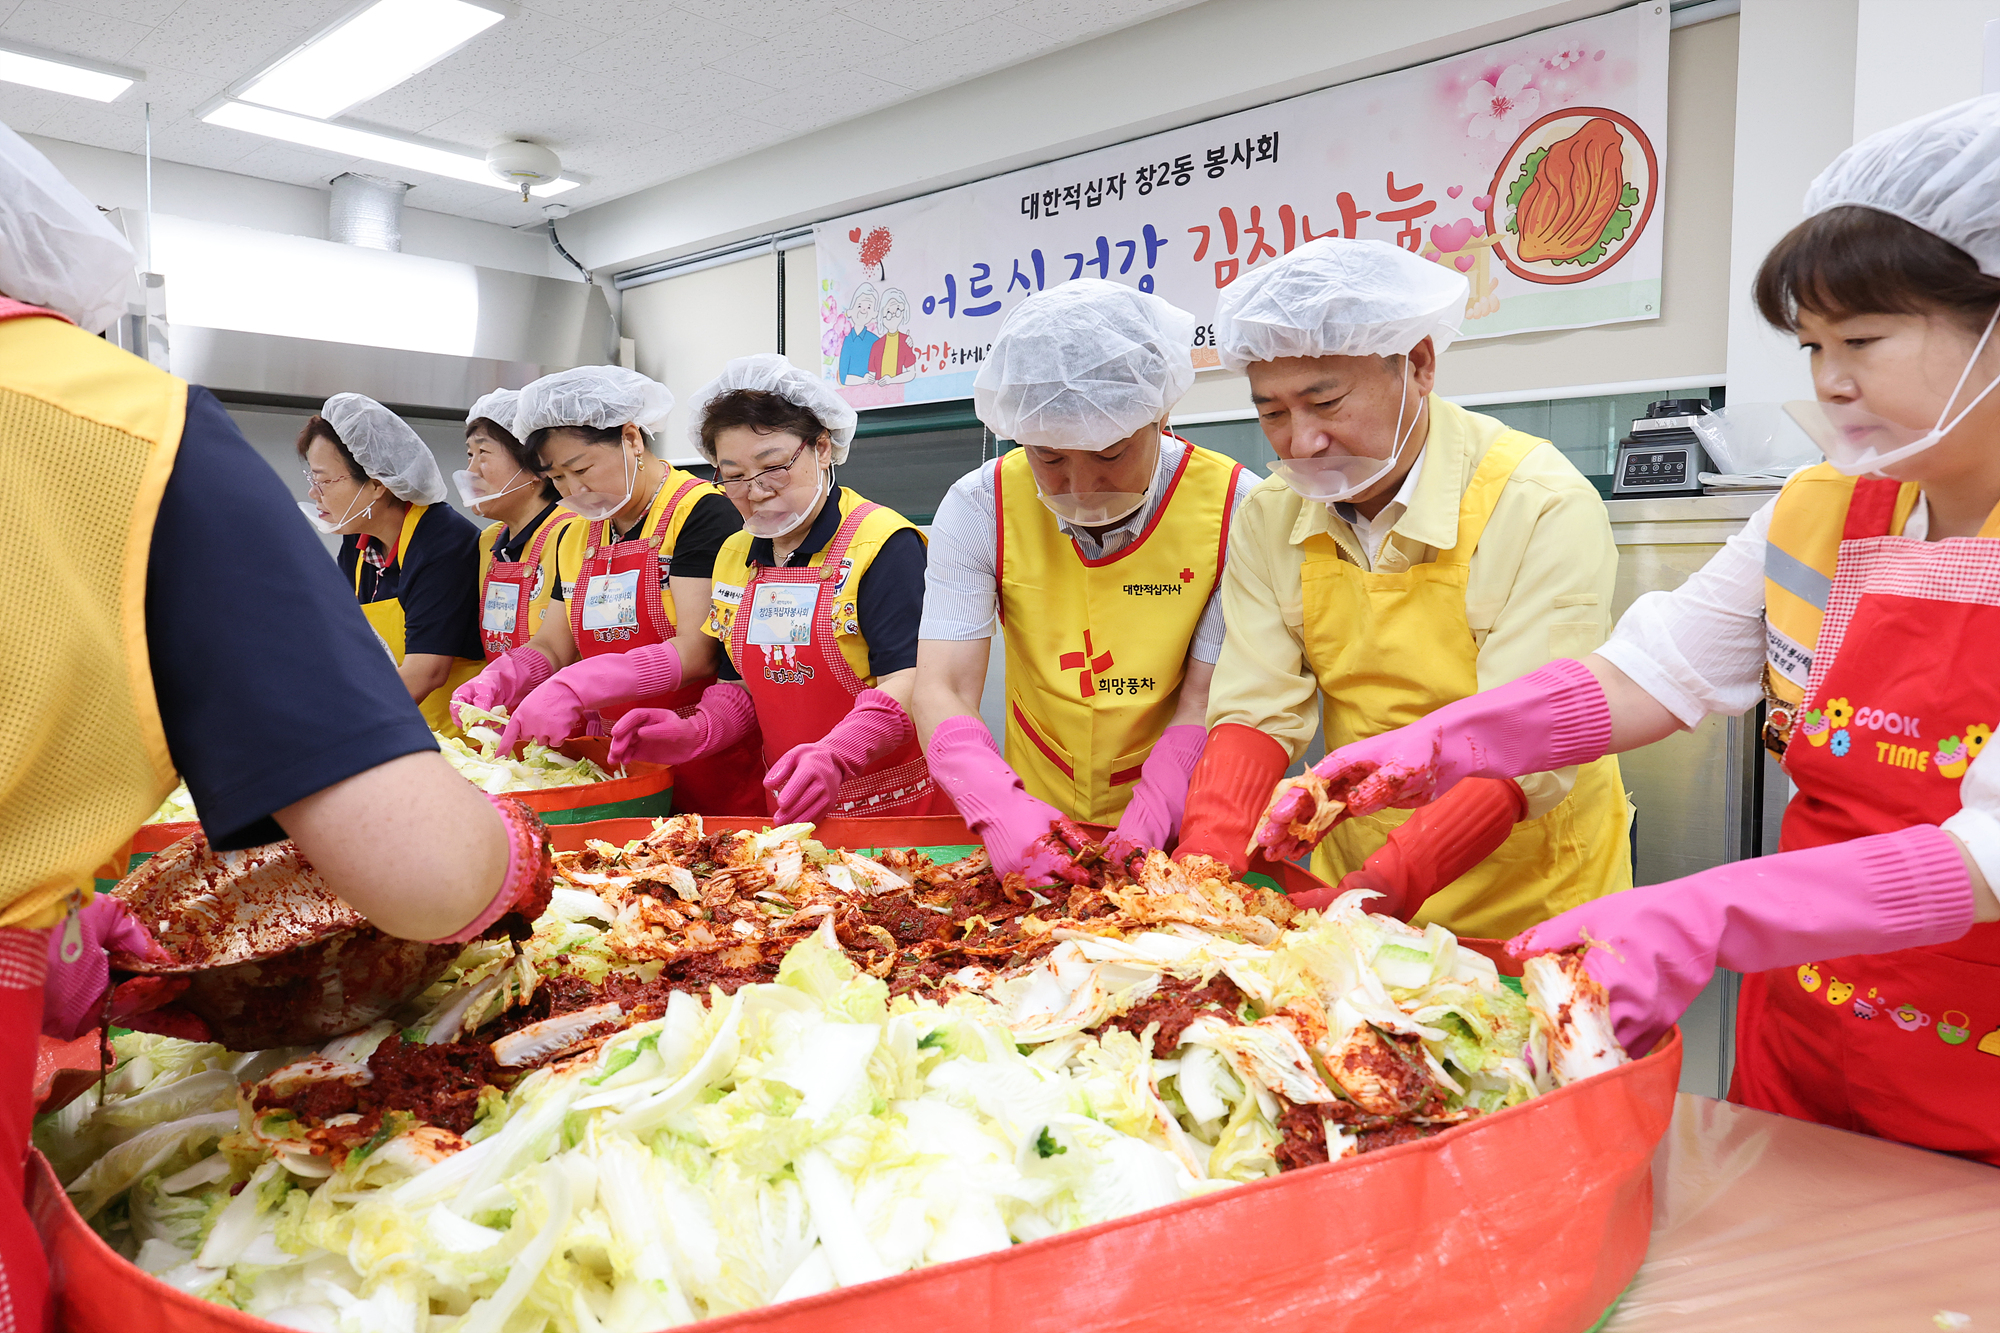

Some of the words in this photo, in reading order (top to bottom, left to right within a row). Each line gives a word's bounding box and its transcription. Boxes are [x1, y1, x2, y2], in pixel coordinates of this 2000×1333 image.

[1021, 173, 1126, 220] 대한적십자
[1136, 154, 1195, 196] 창2동
[1204, 131, 1279, 179] 봉사회
[1123, 584, 1182, 596] 대한적십자사
[759, 607, 773, 618] 창2동
[774, 607, 809, 618] 적십자봉사회
[1098, 677, 1156, 696] 희망풍차
[1854, 706, 1921, 738] COOK
[1876, 741, 1930, 772] TIME
